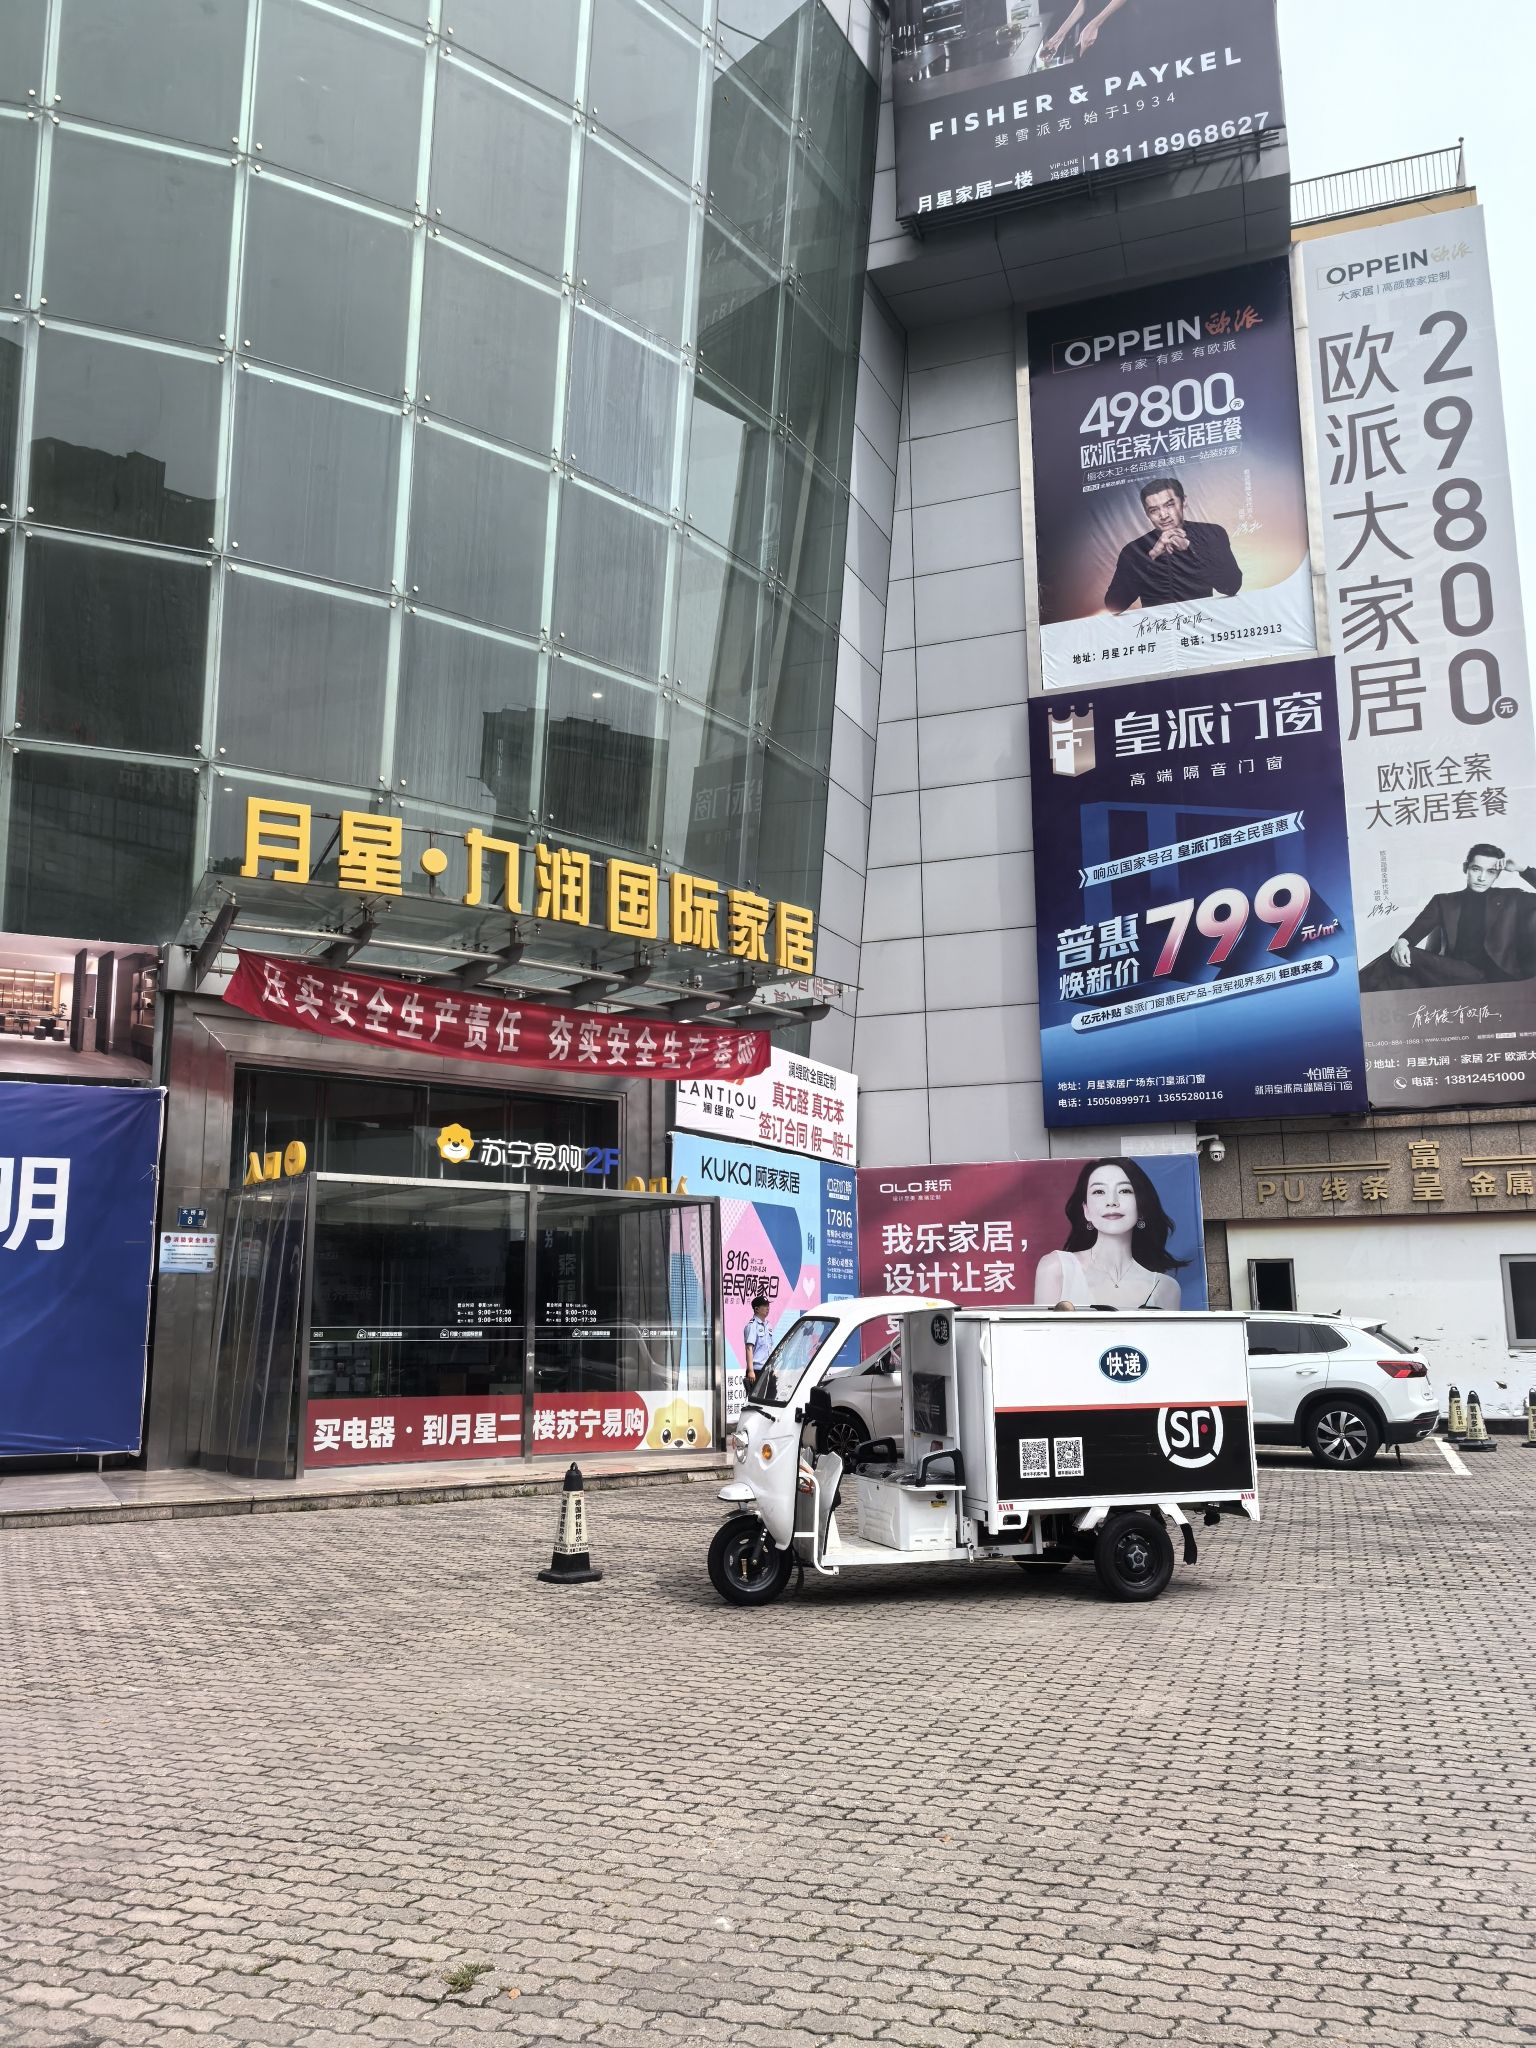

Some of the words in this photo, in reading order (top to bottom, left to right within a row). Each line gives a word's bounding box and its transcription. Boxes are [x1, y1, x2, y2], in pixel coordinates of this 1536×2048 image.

[928, 91, 1054, 141] FISHER
[1068, 85, 1090, 105] &
[1104, 46, 1242, 97] PAYKEL
[1089, 110, 1270, 172] 18118968627
[917, 170, 1034, 215] 月星家居一楼
[1326, 248, 1429, 285] OPPEIN
[1064, 315, 1201, 367] OPPEIN
[1079, 372, 1235, 438] 49800
[1080, 416, 1242, 469] 欧派全案大家居套餐
[1318, 323, 1427, 741] 欧派大家居
[1114, 691, 1323, 759] 皇派门窗
[1129, 755, 1283, 787] 高端隔音门窗
[1377, 753, 1492, 793] 欧派全案
[1365, 786, 1508, 831] 大家居套餐
[1056, 912, 1140, 970] 普惠
[1145, 872, 1311, 978] 799
[1059, 957, 1140, 1001] 焕新价
[262, 960, 522, 1053] 压实安全生产责任
[678, 1080, 756, 1110] LANTIOU
[481, 1138, 584, 1173] 苏宁易购
[584, 1146, 621, 1175] 2F
[758, 1111, 808, 1149] 签订合同
[811, 1124, 854, 1161] 假一赔十
[754, 1165, 800, 1195] 顾家家居
[880, 1182, 922, 1194] OLO
[924, 1179, 952, 1192] 我乐
[0, 1156, 71, 1251] 明
[826, 1208, 852, 1229] 17816
[726, 1249, 750, 1272] 816
[883, 1260, 1016, 1295] 设计让家
[1106, 1352, 1142, 1378] 快递
